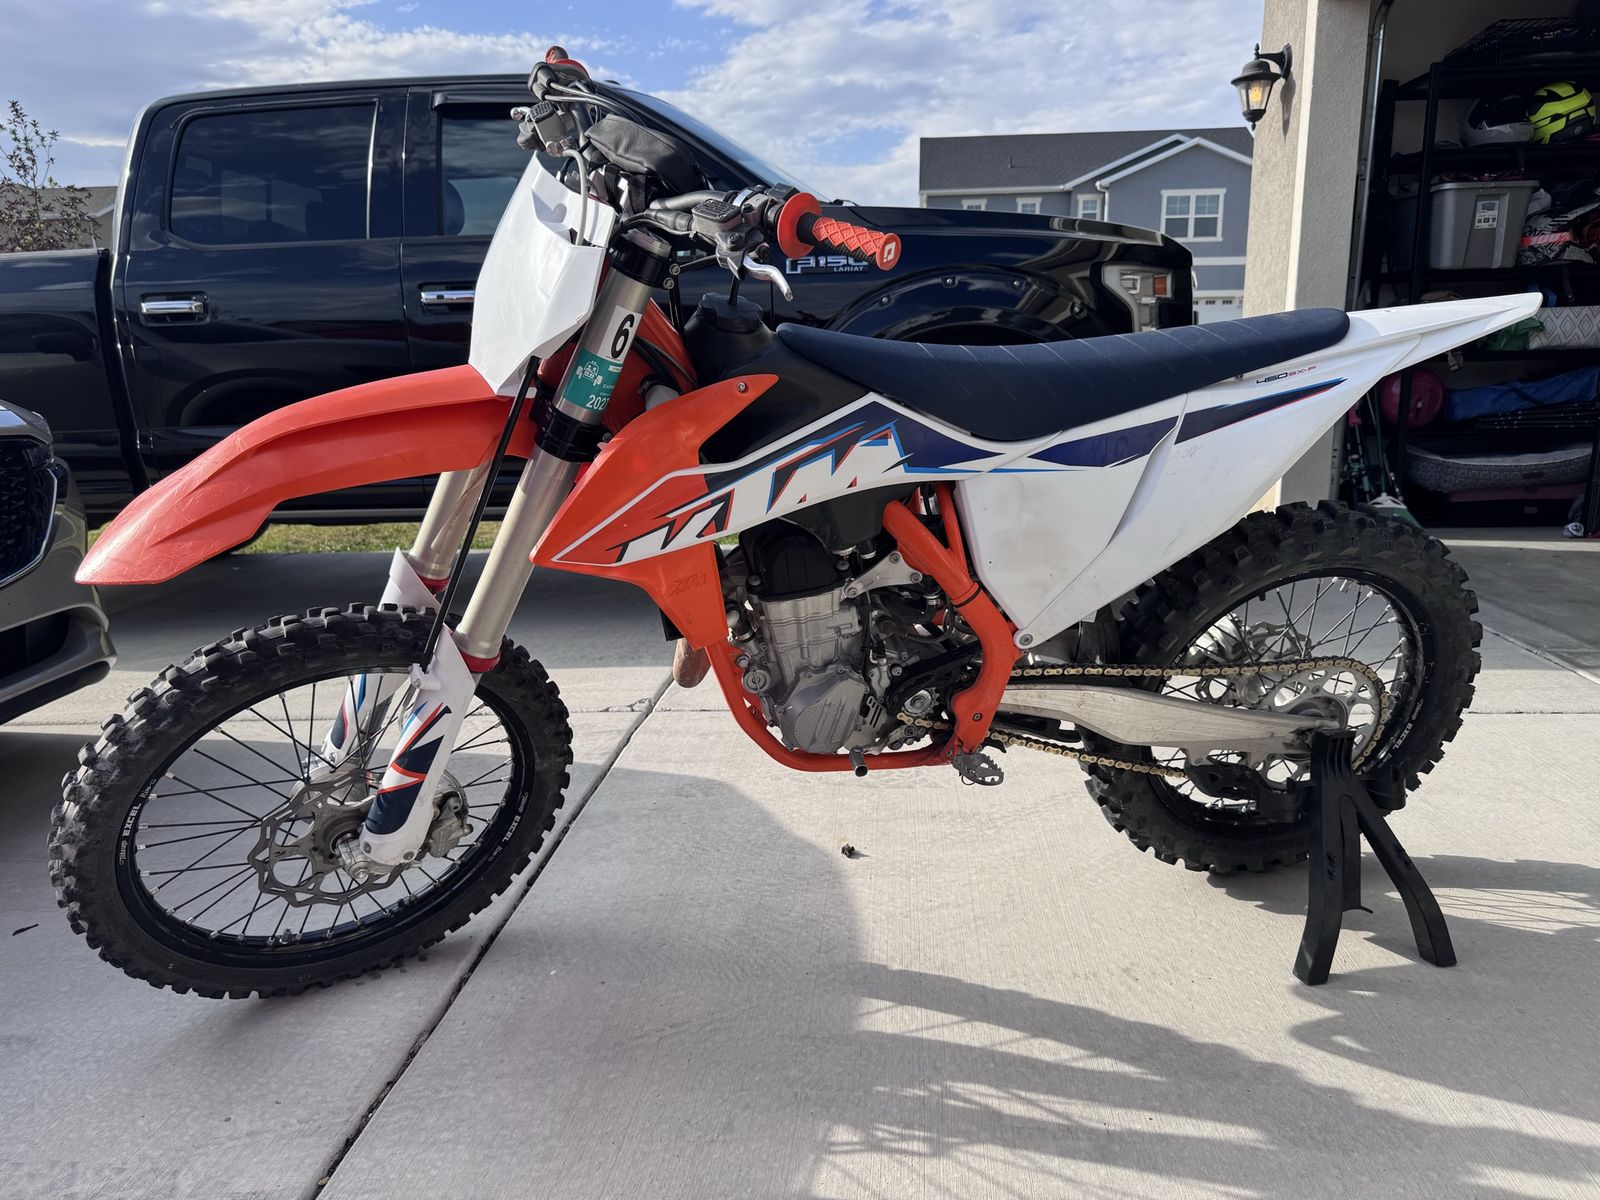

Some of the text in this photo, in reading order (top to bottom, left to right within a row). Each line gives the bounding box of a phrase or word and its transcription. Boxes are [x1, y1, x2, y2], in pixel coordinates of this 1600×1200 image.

[611, 313, 635, 359] 6
[122, 803, 142, 837] EXCEL
[502, 815, 521, 842] EXCEL
